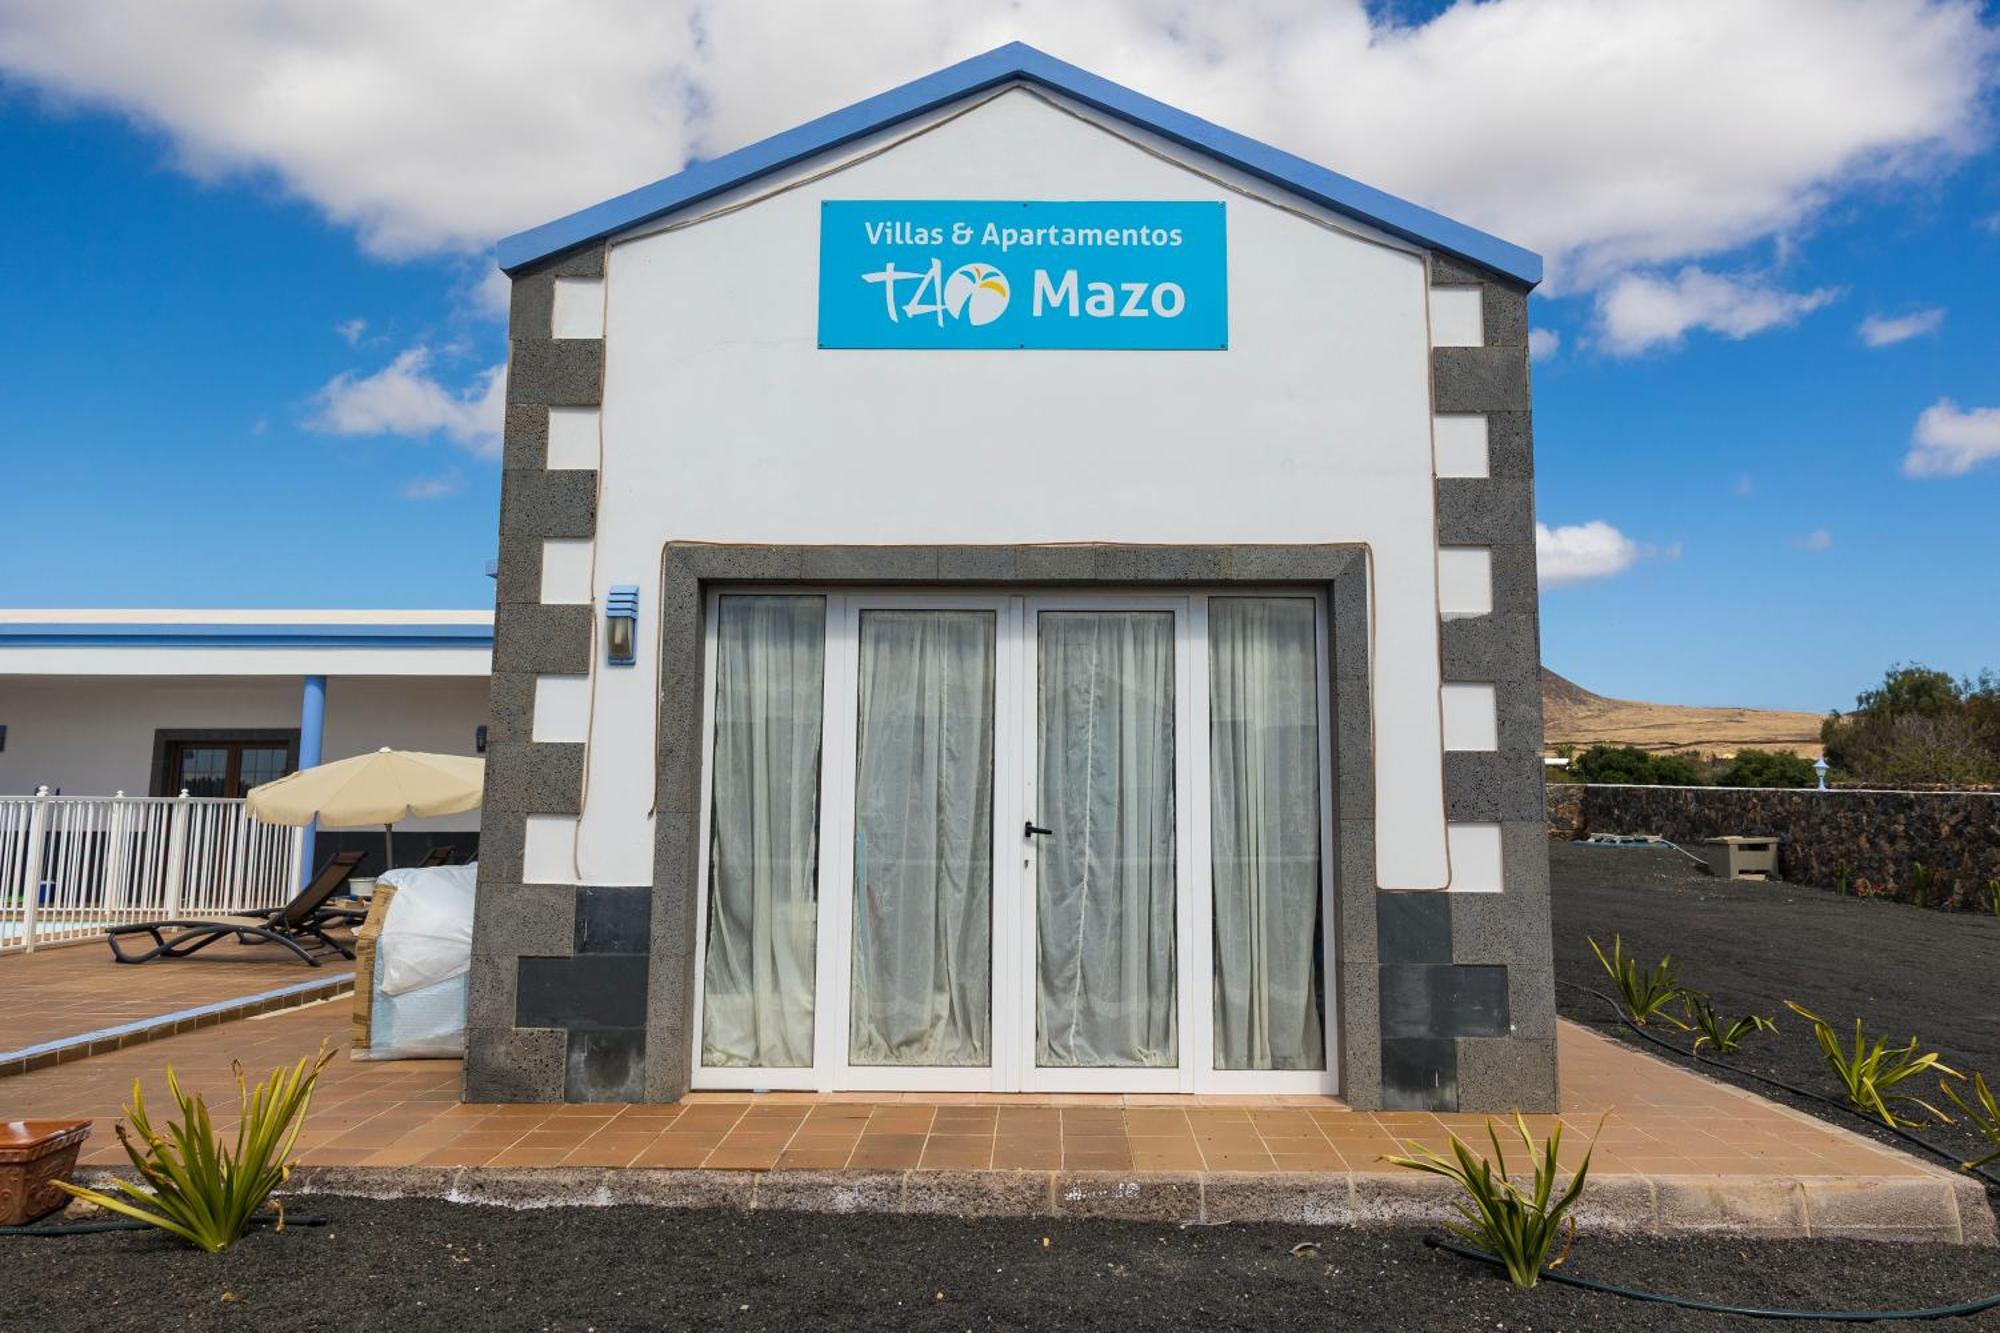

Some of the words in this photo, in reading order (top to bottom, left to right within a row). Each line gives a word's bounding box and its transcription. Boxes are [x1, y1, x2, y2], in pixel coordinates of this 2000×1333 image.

[865, 222, 943, 245] Villas
[952, 222, 973, 245] &
[982, 222, 1183, 252] Apartamentos
[1032, 269, 1186, 318] Mazo
